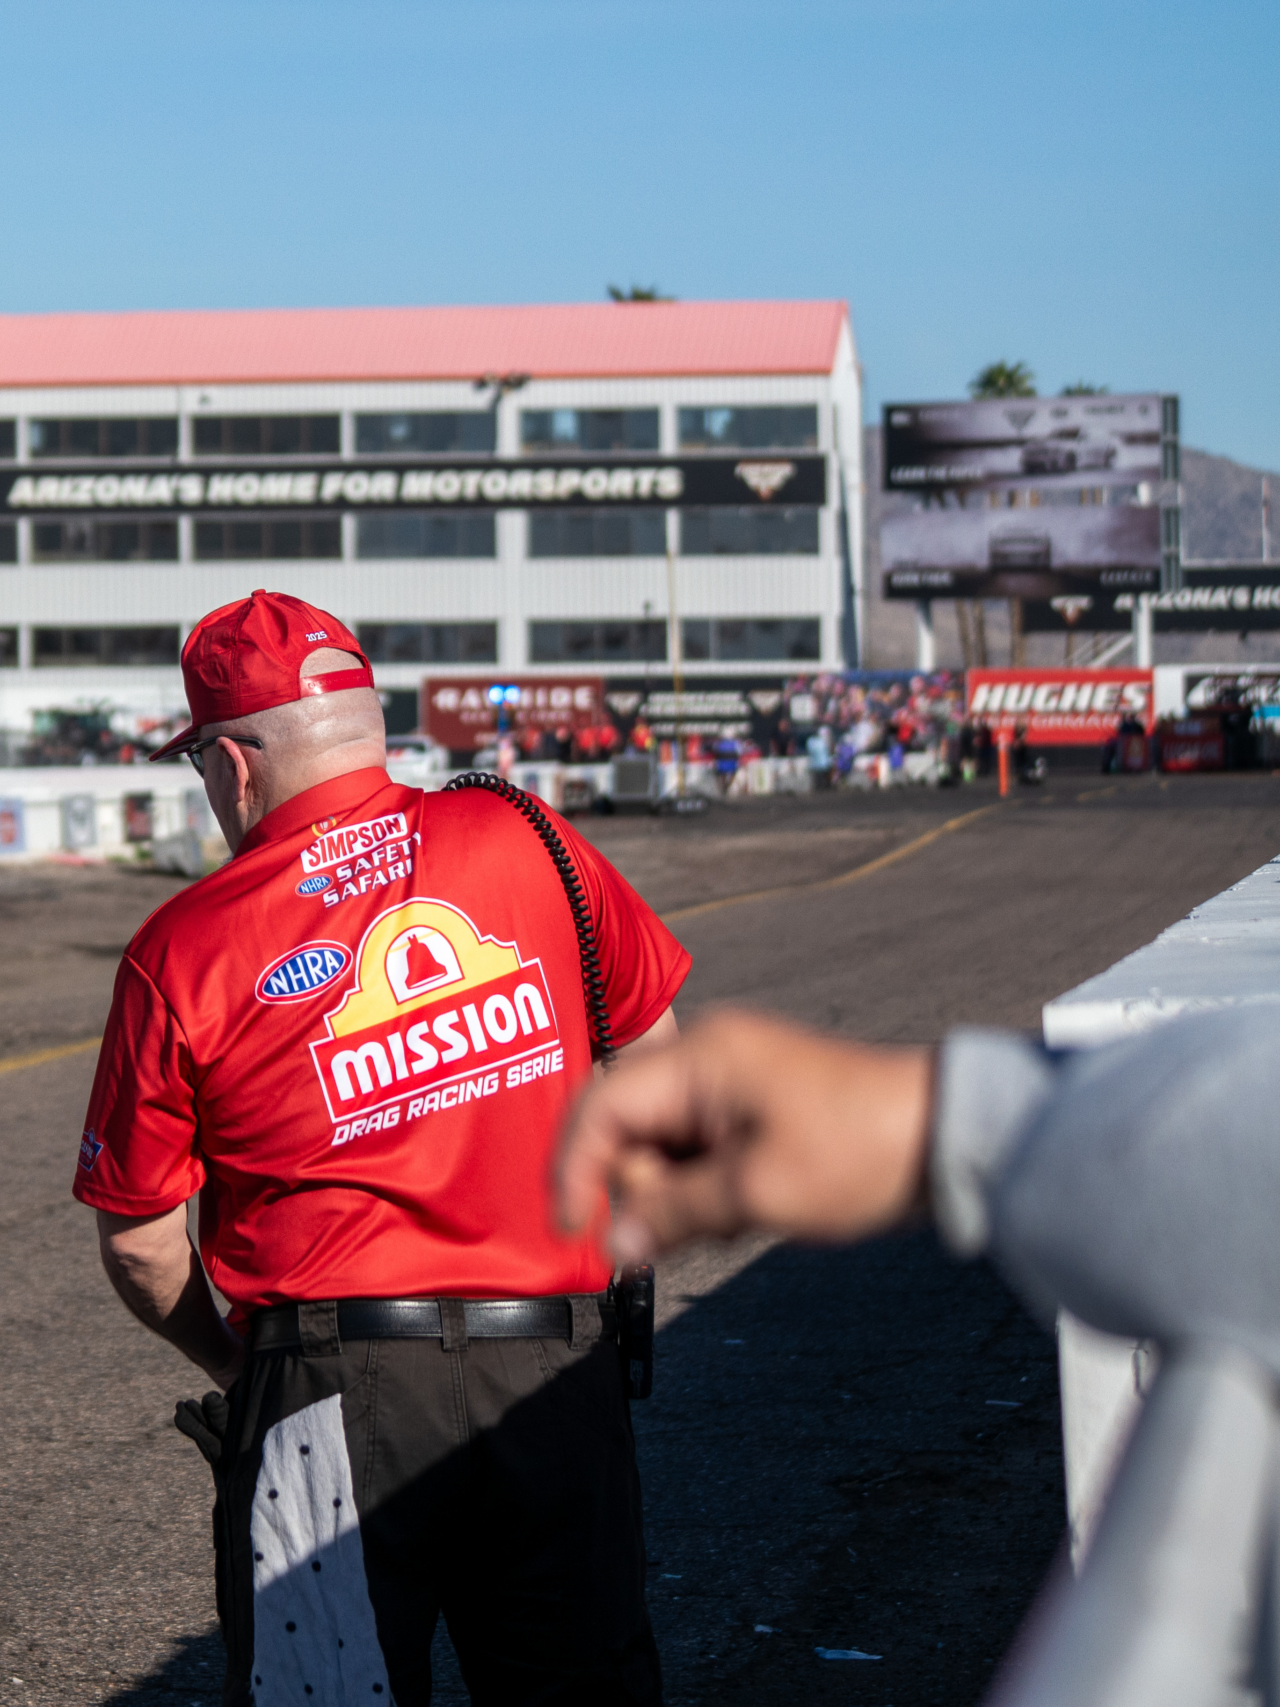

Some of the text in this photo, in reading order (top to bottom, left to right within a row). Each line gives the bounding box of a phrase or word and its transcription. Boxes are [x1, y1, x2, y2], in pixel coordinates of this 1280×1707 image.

[8, 467, 684, 506] ARIZONA'S HOME FOR MOTORSPORTS
[305, 631, 328, 642] 2025
[971, 682, 1151, 713] HUGHES
[306, 815, 404, 868] SIMPSON
[299, 875, 331, 894] NHRA
[322, 858, 414, 909] SAFARI
[269, 947, 342, 997] NHRA
[330, 982, 551, 1102] MISSION
[331, 1046, 564, 1147] DRAG RACING SERIE
